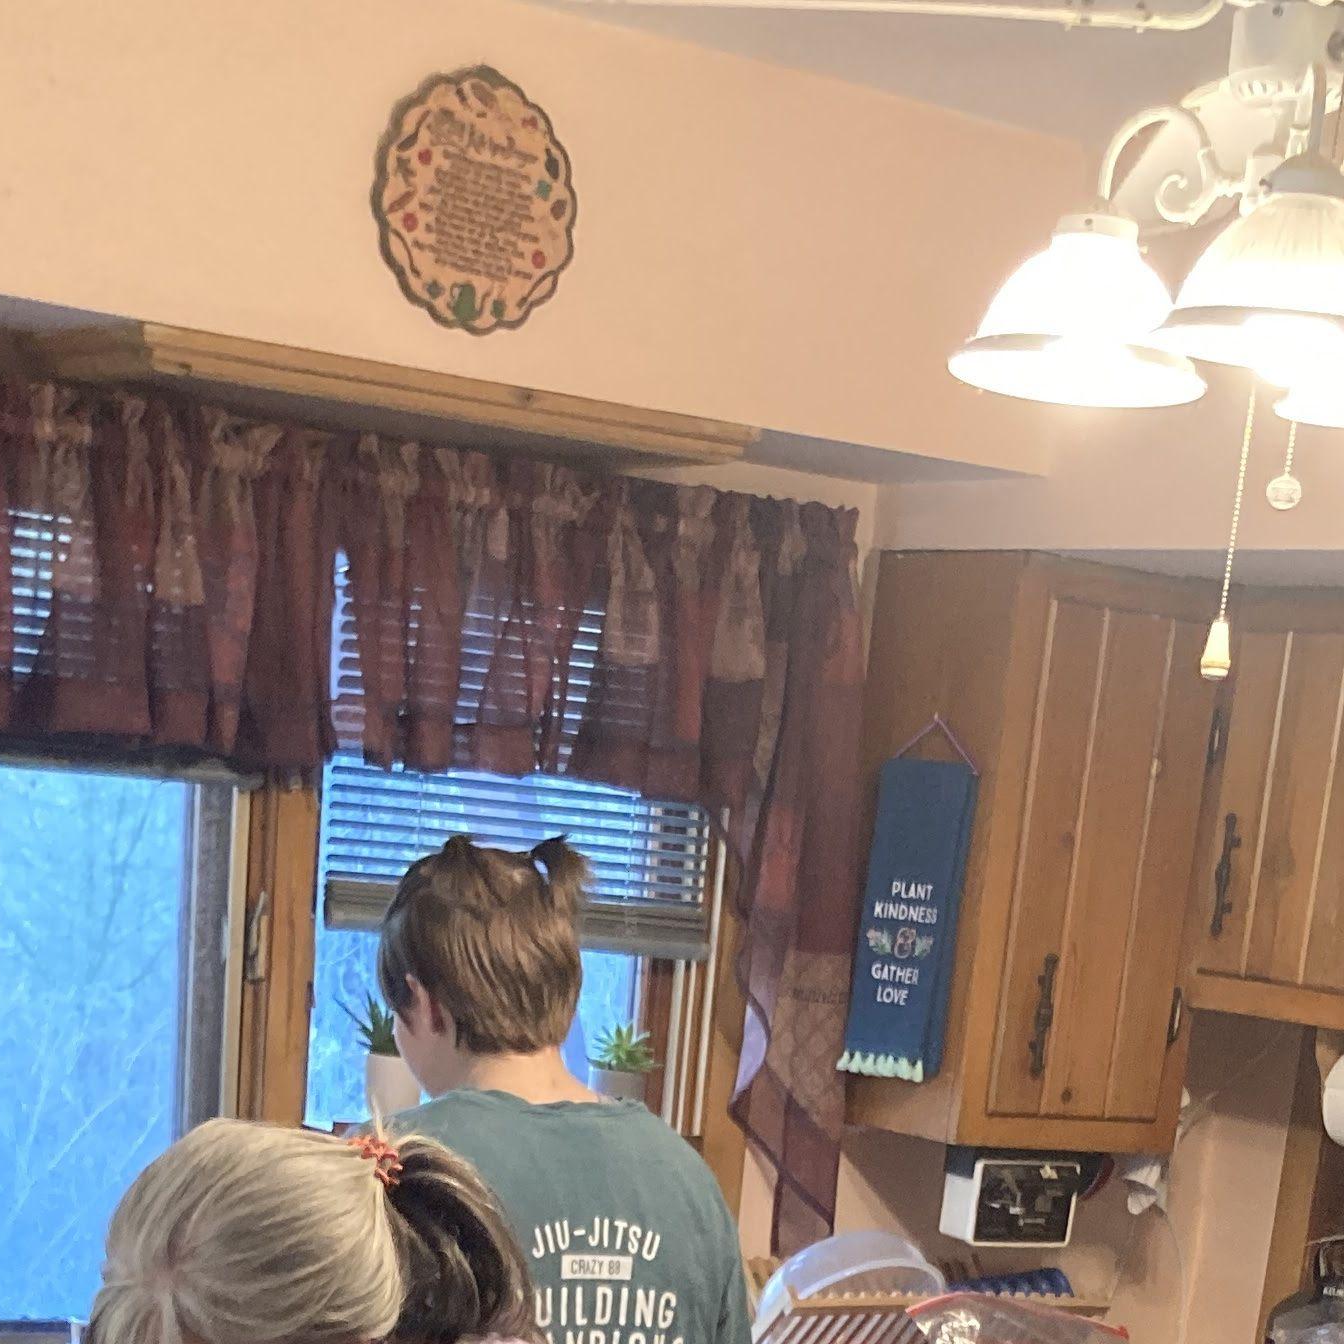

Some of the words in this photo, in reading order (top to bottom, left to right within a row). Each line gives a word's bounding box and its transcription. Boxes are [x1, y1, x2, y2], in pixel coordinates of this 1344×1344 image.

[891, 880, 934, 901] PLANT
[873, 900, 938, 924] KINDNESS
[871, 963, 919, 985] GATHER
[876, 985, 909, 1006] LOVE
[531, 1216, 661, 1261] JIU-JITSU
[570, 1259, 604, 1275] CRAZY
[534, 1285, 678, 1329] UILDING
